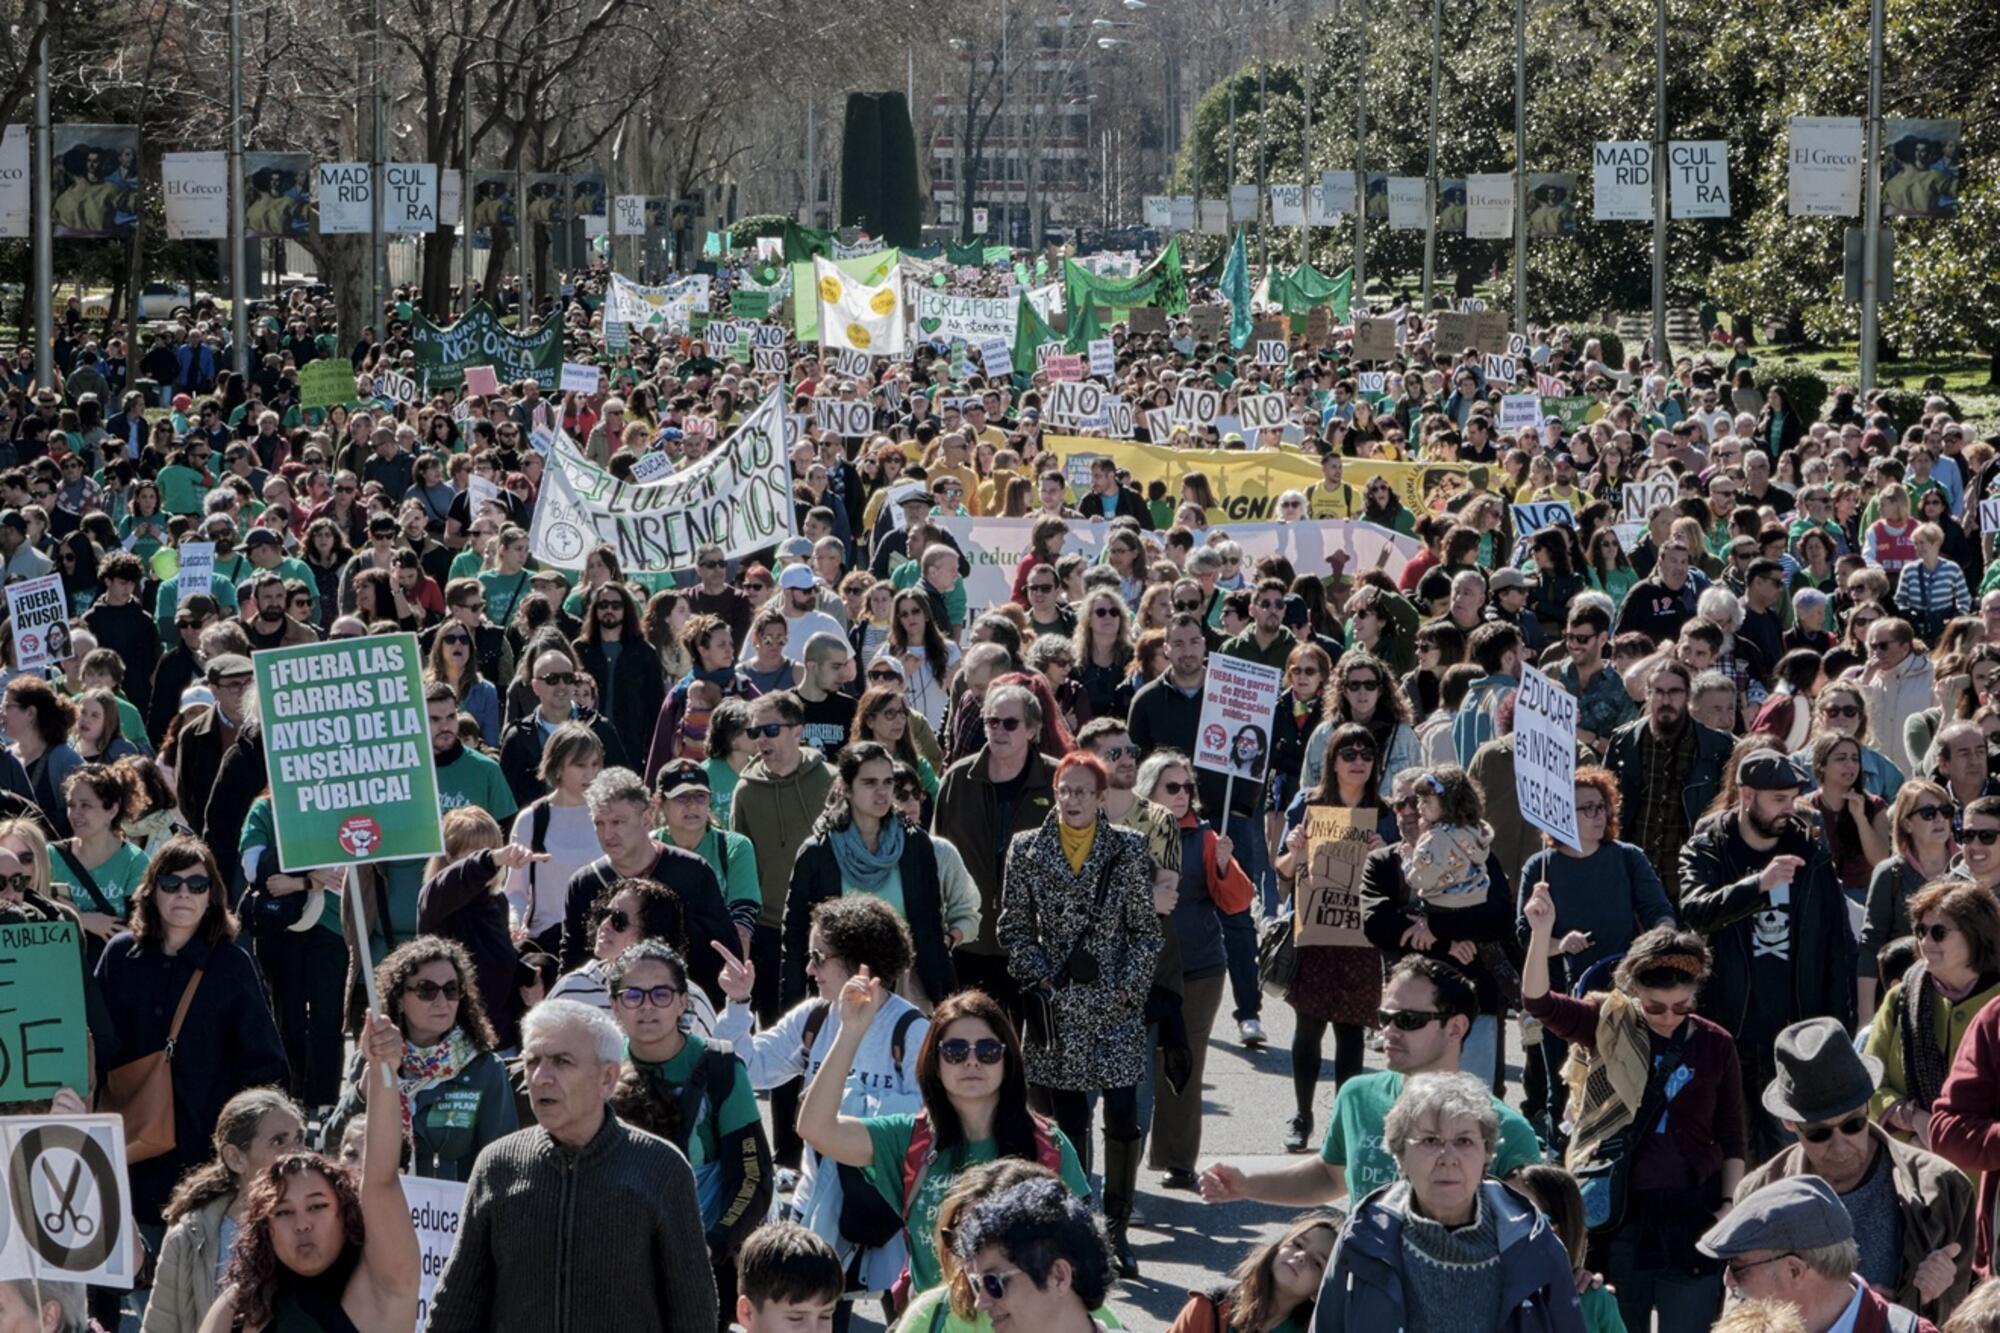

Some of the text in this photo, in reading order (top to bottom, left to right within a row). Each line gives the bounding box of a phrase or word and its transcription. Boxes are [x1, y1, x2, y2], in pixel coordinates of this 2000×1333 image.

[1596, 147, 1649, 165] MAD
[1672, 147, 1717, 165] CUL
[1794, 148, 1857, 165] El Greco
[320, 168, 369, 185] MAD
[387, 168, 426, 186] CUL
[1615, 167, 1649, 185] RID
[1680, 166, 1709, 184] TU
[168, 180, 222, 195] El Greco
[338, 186, 369, 202] RID
[393, 186, 419, 203] TU
[1696, 185, 1726, 203] RA
[407, 204, 433, 220] RA
[616, 199, 639, 209] CUL
[621, 208, 635, 217] TU
[627, 217, 643, 227] RA
[412, 327, 427, 342] LA
[710, 322, 737, 344] NO
[756, 327, 783, 346] NO
[442, 331, 480, 364] NOS
[1259, 342, 1286, 362] NO
[755, 350, 785, 371] NO
[842, 349, 869, 377] NO
[1487, 356, 1514, 380] NO
[385, 371, 413, 402] NO
[1361, 374, 1383, 389] NO
[1056, 384, 1100, 416] NO
[1176, 391, 1215, 422] NO
[1241, 396, 1284, 427] NO
[827, 404, 870, 434] NO
[1109, 405, 1131, 435] NO
[633, 454, 667, 479] EDUCAR
[1625, 484, 1675, 520] NO
[1513, 503, 1572, 534] NO
[14, 587, 60, 615] ¡FUERA
[17, 604, 64, 630] AYUSO!
[269, 645, 405, 690] ¡FUERA LAS
[273, 676, 411, 717] GARRAS DE
[1518, 671, 1574, 736] EDUCAR
[271, 707, 421, 751] AYUSO DE LA
[1516, 731, 1527, 759] es
[279, 741, 421, 783] ENSEÑANZA
[297, 774, 412, 812] PÚBLICA!
[1530, 779, 1541, 817] ES
[3, 926, 71, 949] PUBLICA
